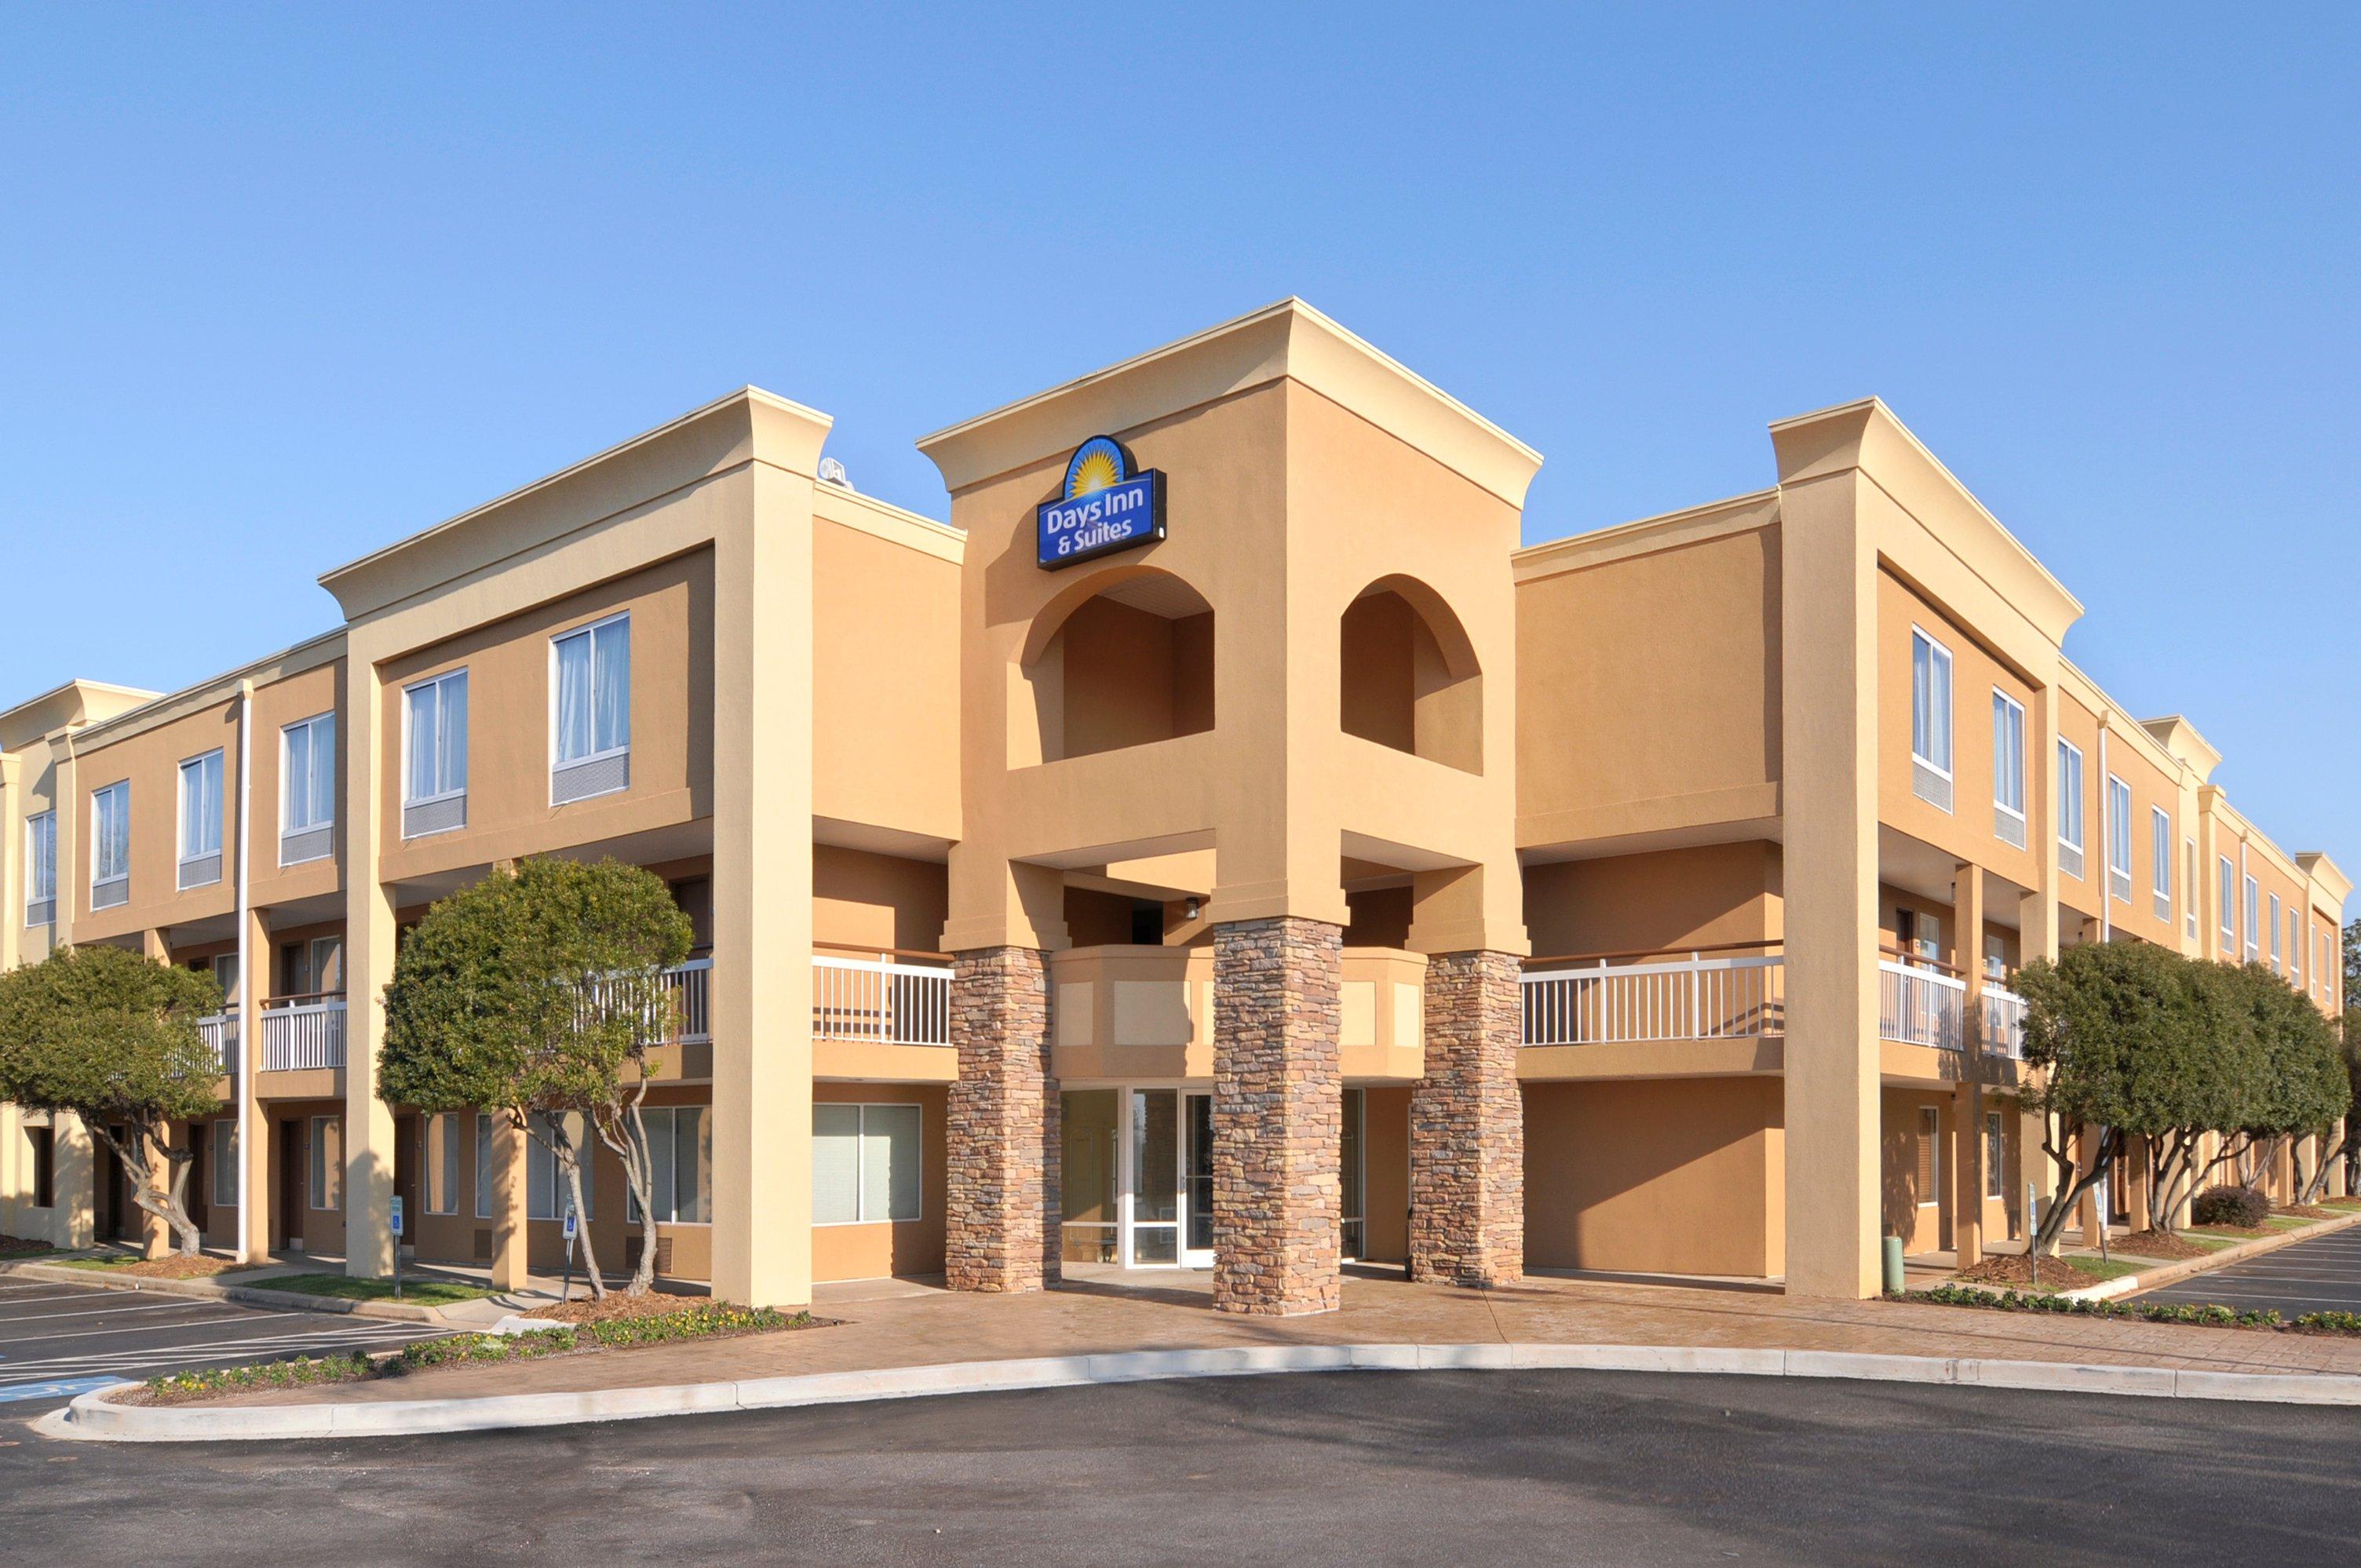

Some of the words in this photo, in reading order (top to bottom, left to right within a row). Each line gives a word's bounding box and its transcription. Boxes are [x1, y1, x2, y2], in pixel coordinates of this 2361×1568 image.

[1048, 501, 1101, 534] Days
[1105, 488, 1143, 516] Inn
[1057, 536, 1071, 555] &
[1075, 519, 1132, 551] Suites
